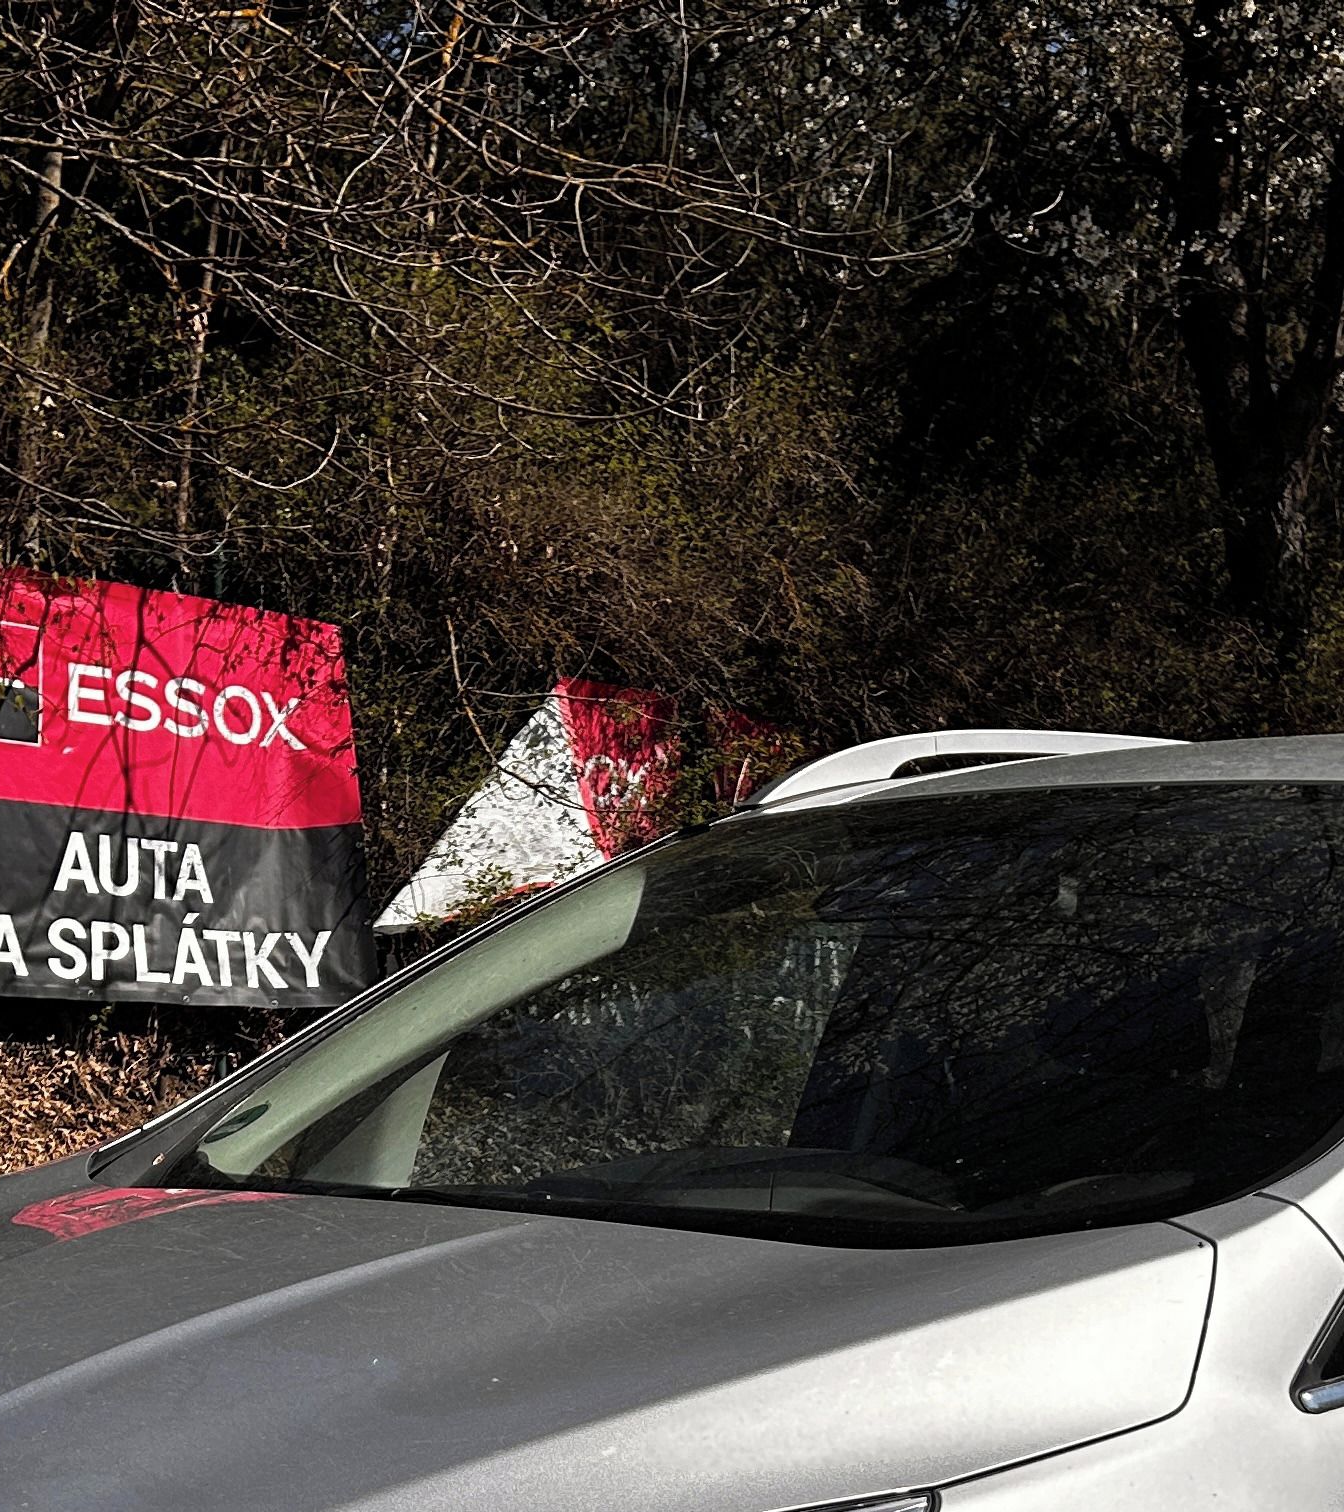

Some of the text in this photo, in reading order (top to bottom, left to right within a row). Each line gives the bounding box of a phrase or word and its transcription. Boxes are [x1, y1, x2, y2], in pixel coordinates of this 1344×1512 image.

[68, 662, 308, 750] ESSOX
[53, 831, 214, 904] AUTA
[46, 911, 333, 990] SPLÁTKY
